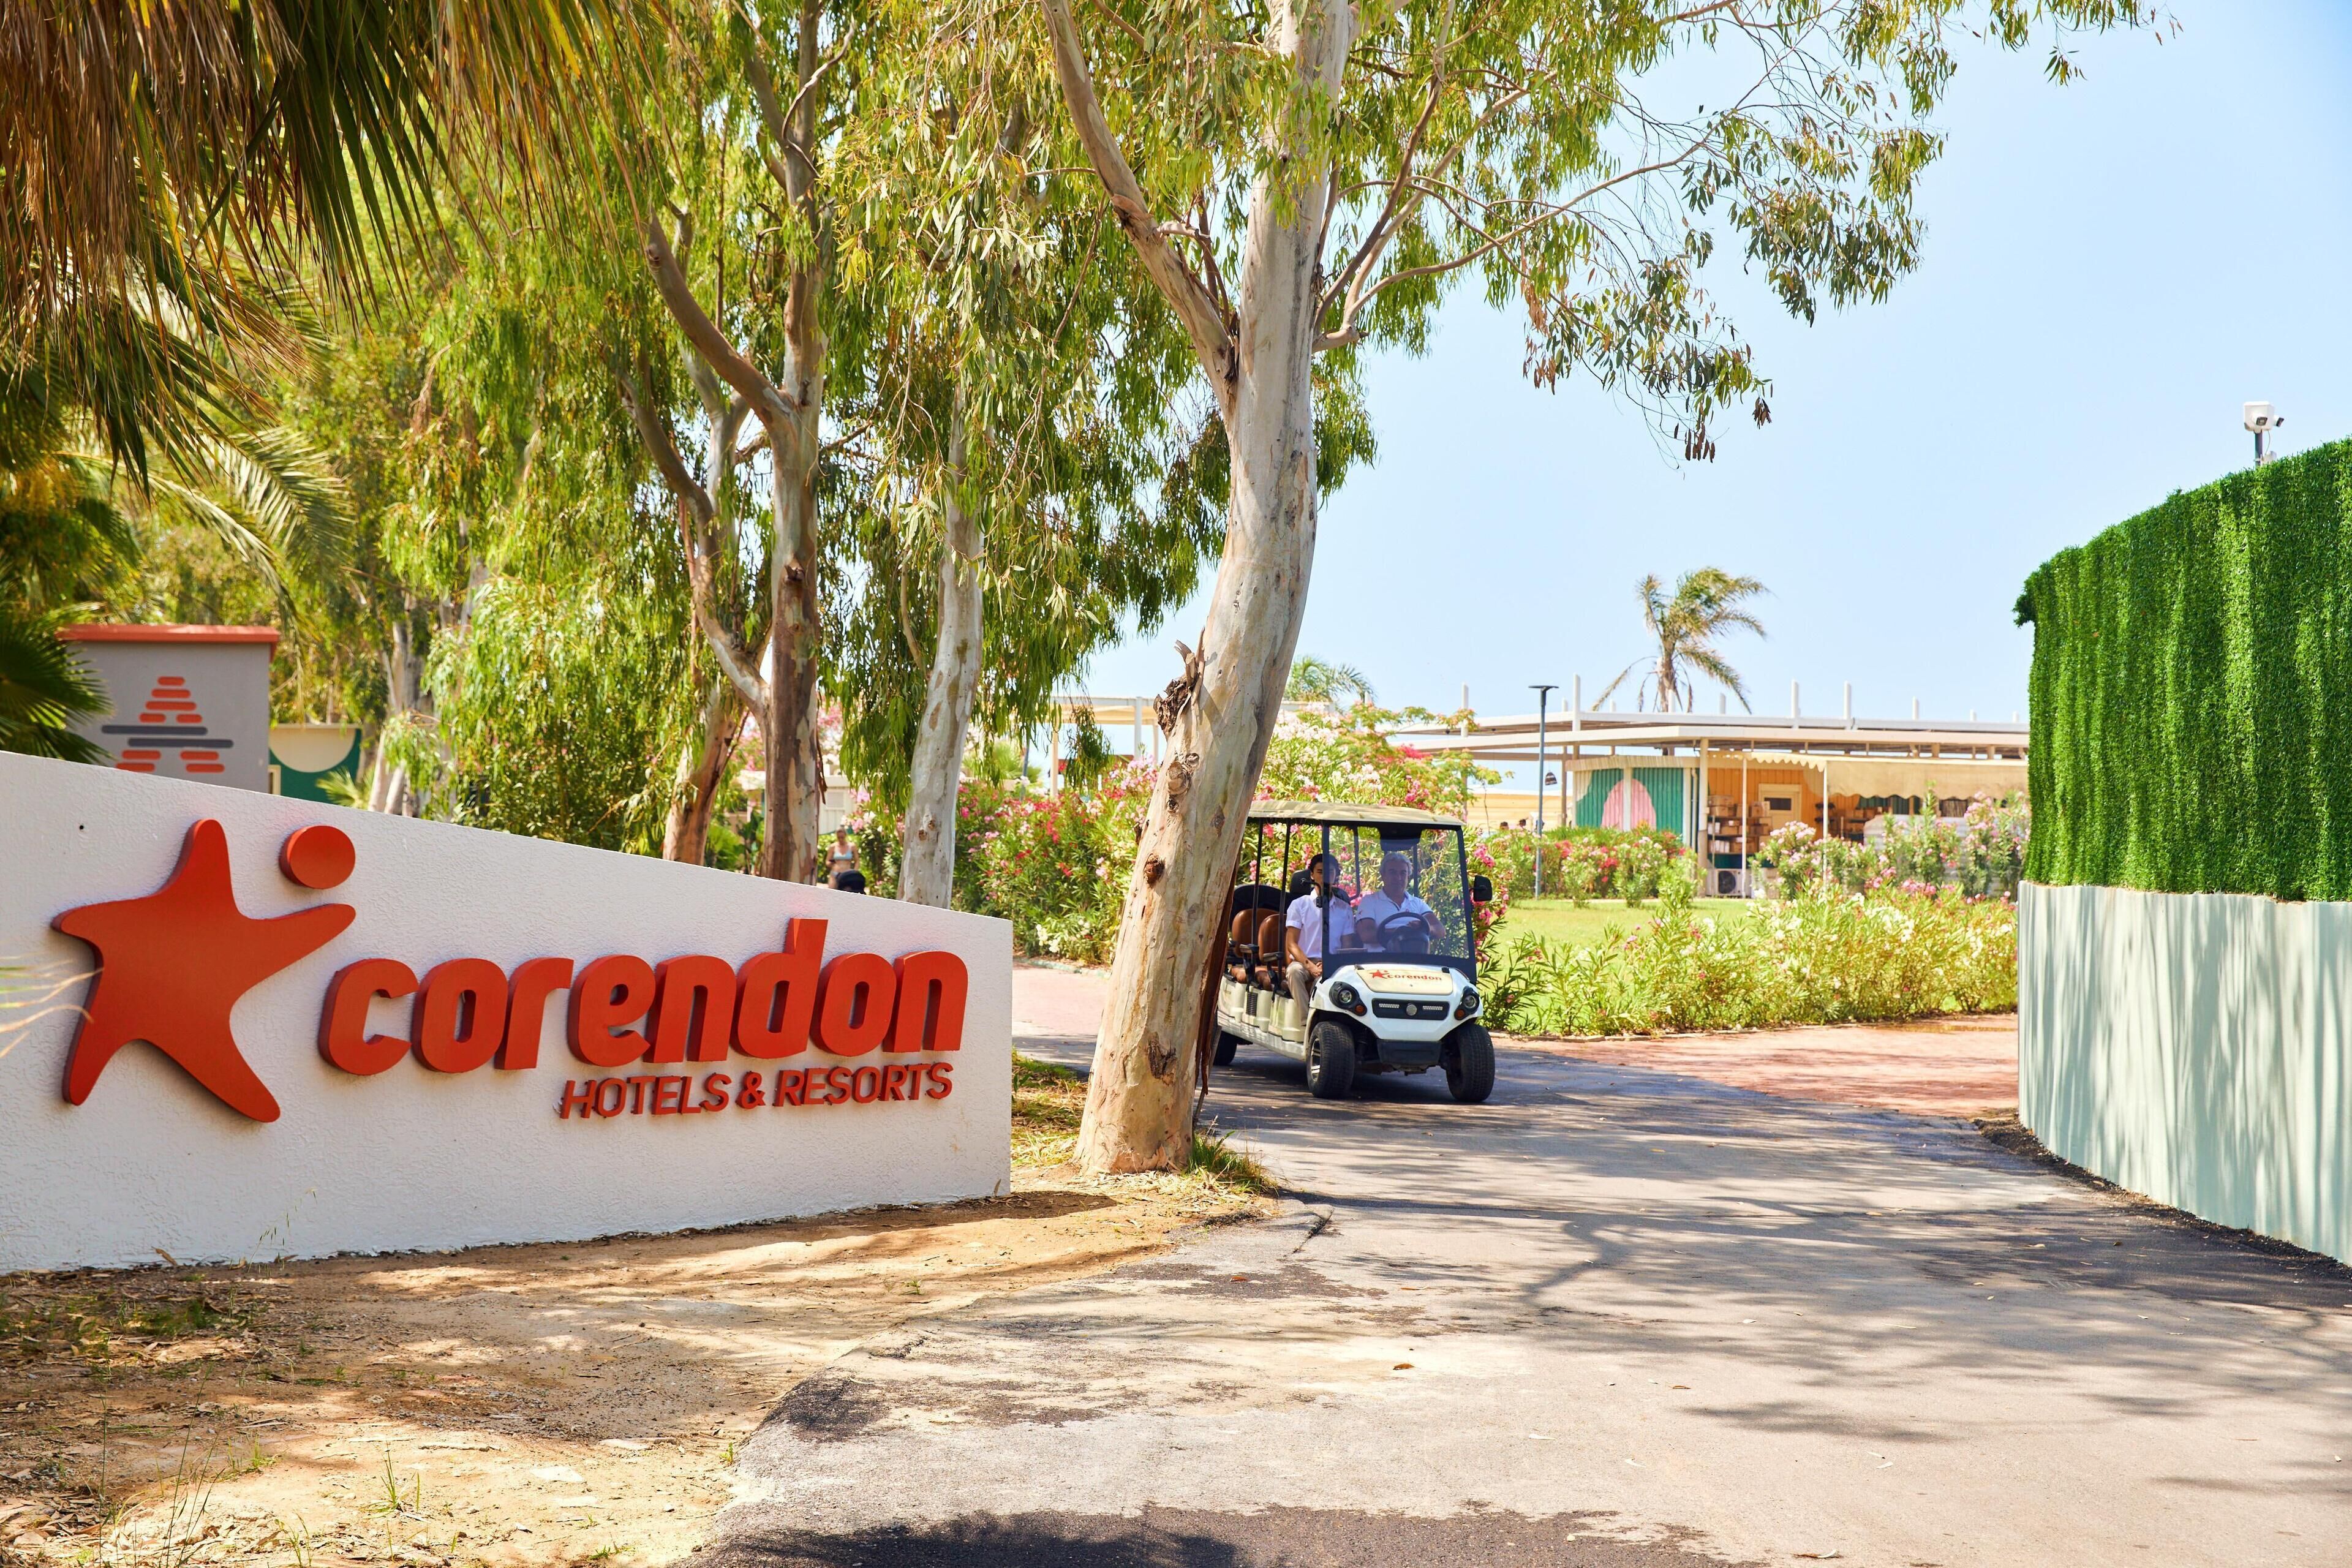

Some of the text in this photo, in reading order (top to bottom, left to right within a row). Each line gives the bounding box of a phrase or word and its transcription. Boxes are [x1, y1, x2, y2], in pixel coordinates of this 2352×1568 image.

[318, 918, 968, 1076] corendon
[560, 1061, 954, 1120] HOTELS & RESORTS
